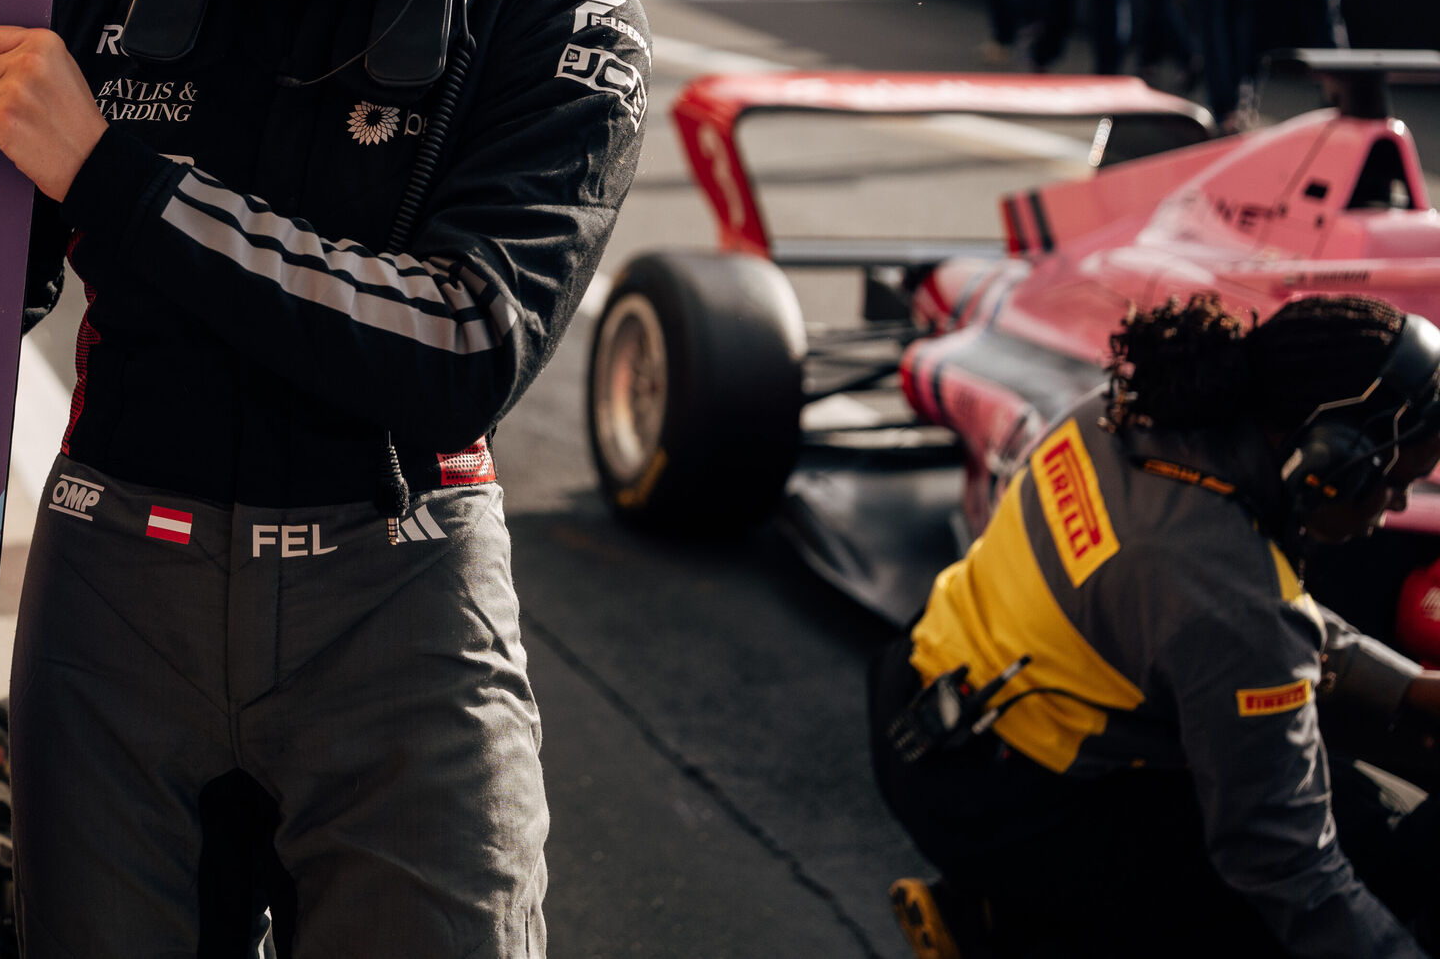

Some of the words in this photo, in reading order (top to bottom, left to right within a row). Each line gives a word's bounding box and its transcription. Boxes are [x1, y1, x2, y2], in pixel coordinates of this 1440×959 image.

[98, 78, 174, 102] BAYLIS
[179, 82, 198, 102] &
[51, 479, 101, 514] OMP
[1043, 436, 1102, 560] PIRELLI
[252, 523, 339, 559] FEL
